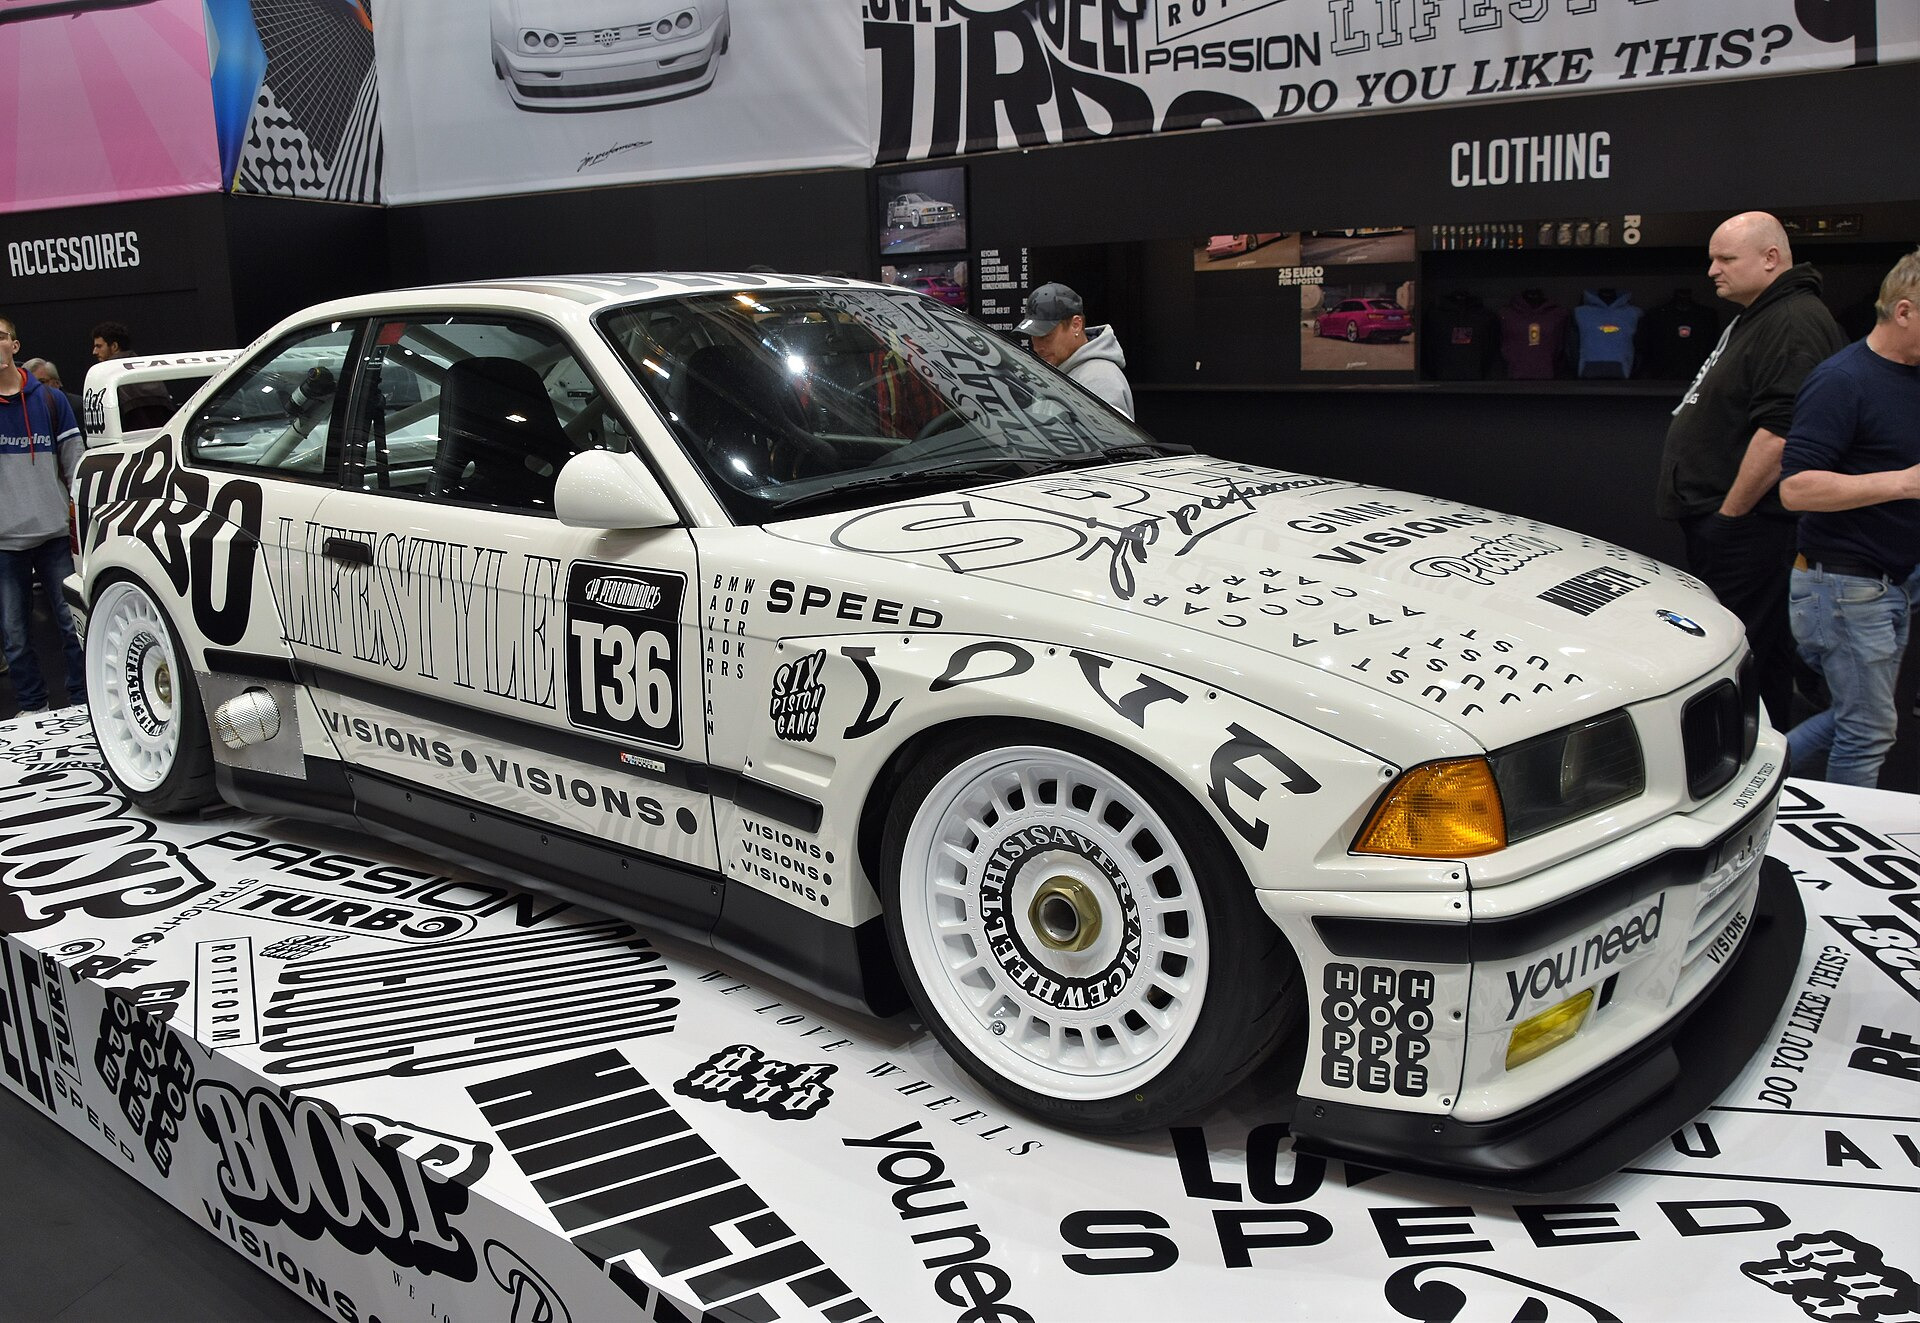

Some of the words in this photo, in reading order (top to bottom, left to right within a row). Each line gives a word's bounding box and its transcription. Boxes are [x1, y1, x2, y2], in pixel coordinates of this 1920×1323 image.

[1145, 31, 1321, 74] PASSION
[1273, 79, 1338, 118] DO
[1356, 63, 1456, 108] YOU
[1466, 47, 1594, 96] LIKE
[1614, 23, 1794, 80] THIS?
[1450, 131, 1611, 188] CLOTHING
[8, 231, 140, 277] ACCESSOIRES
[1278, 267, 1293, 279] 25
[1293, 265, 1324, 279] EURO
[1296, 276, 1324, 285] POSTER
[1287, 500, 1414, 534] GIMME
[1312, 512, 1493, 566] VISIONS
[277, 517, 562, 710] LIFESTYLE
[766, 579, 944, 629] SPEED
[736, 578, 756, 680] WORKS
[571, 619, 673, 729] T36
[773, 651, 824, 695] SIX
[772, 686, 823, 715] PISTON
[777, 713, 817, 734] GANG
[321, 708, 455, 768] VISIONS
[841, 640, 1321, 851] LOVE
[484, 754, 666, 827] VISIONS
[1740, 784, 1757, 802] YOU
[1750, 773, 1767, 790] LIKE
[1758, 762, 1776, 780] THIS?
[1732, 795, 1747, 809] DO
[742, 818, 821, 859] VISIONS
[742, 838, 819, 881] VISIONS
[185, 830, 579, 929] PASSION
[740, 858, 817, 902] VISIONS
[238, 889, 464, 939] TURBO
[1505, 945, 1577, 1022] you
[1580, 891, 1666, 977] need
[1706, 911, 1748, 965] VISIONS
[1806, 944, 1852, 990] THIS?
[211, 943, 241, 1042] ROTIFORM
[1787, 989, 1832, 1035] LIKE
[697, 969, 751, 996] WE
[753, 1002, 854, 1052] LOVE
[866, 1061, 1044, 1156] WHEELS
[1769, 1030, 1815, 1073] YOU
[53, 1069, 135, 1163] SPEED
[1757, 1076, 1799, 1110] DO
[201, 1196, 360, 1323] VISIONS
[1059, 1199, 1792, 1276] SPEED
[392, 1269, 416, 1300] WE
